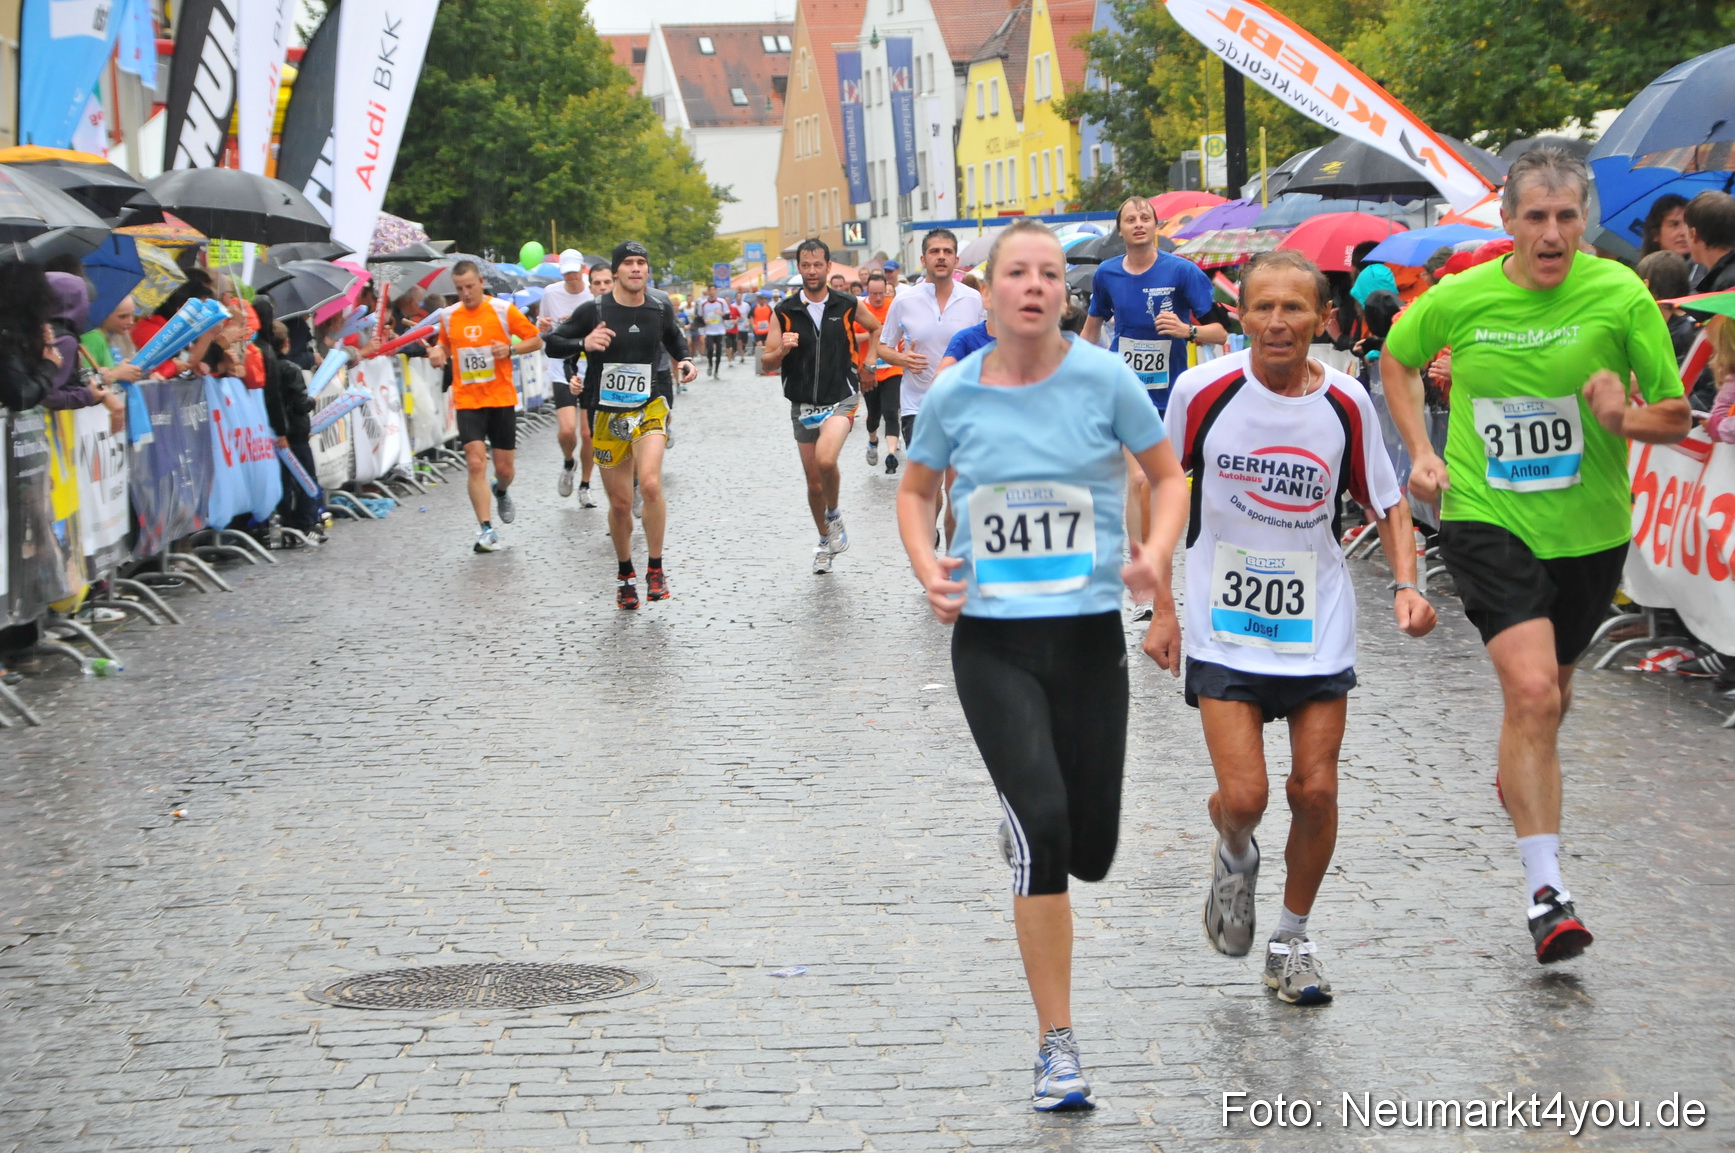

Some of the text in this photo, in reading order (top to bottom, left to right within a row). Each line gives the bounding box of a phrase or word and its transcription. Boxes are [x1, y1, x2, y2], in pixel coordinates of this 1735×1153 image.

[356, 10, 402, 192] Audi BKK
[901, 96, 914, 149] RUPPERT
[1123, 351, 1165, 372] 2628
[605, 373, 646, 393] 3076
[1484, 418, 1572, 458] 3109
[1217, 454, 1324, 483] GERHART &
[1219, 470, 1263, 484] Autohaus
[1511, 464, 1550, 478] Anton
[1261, 476, 1324, 500] JÄNIG
[1230, 495, 1329, 529] Das sportliche Autohaus
[984, 511, 1081, 553] 3417
[1246, 556, 1285, 568] BOCK
[1222, 571, 1305, 615] 3203
[1244, 618, 1279, 637] Josef
